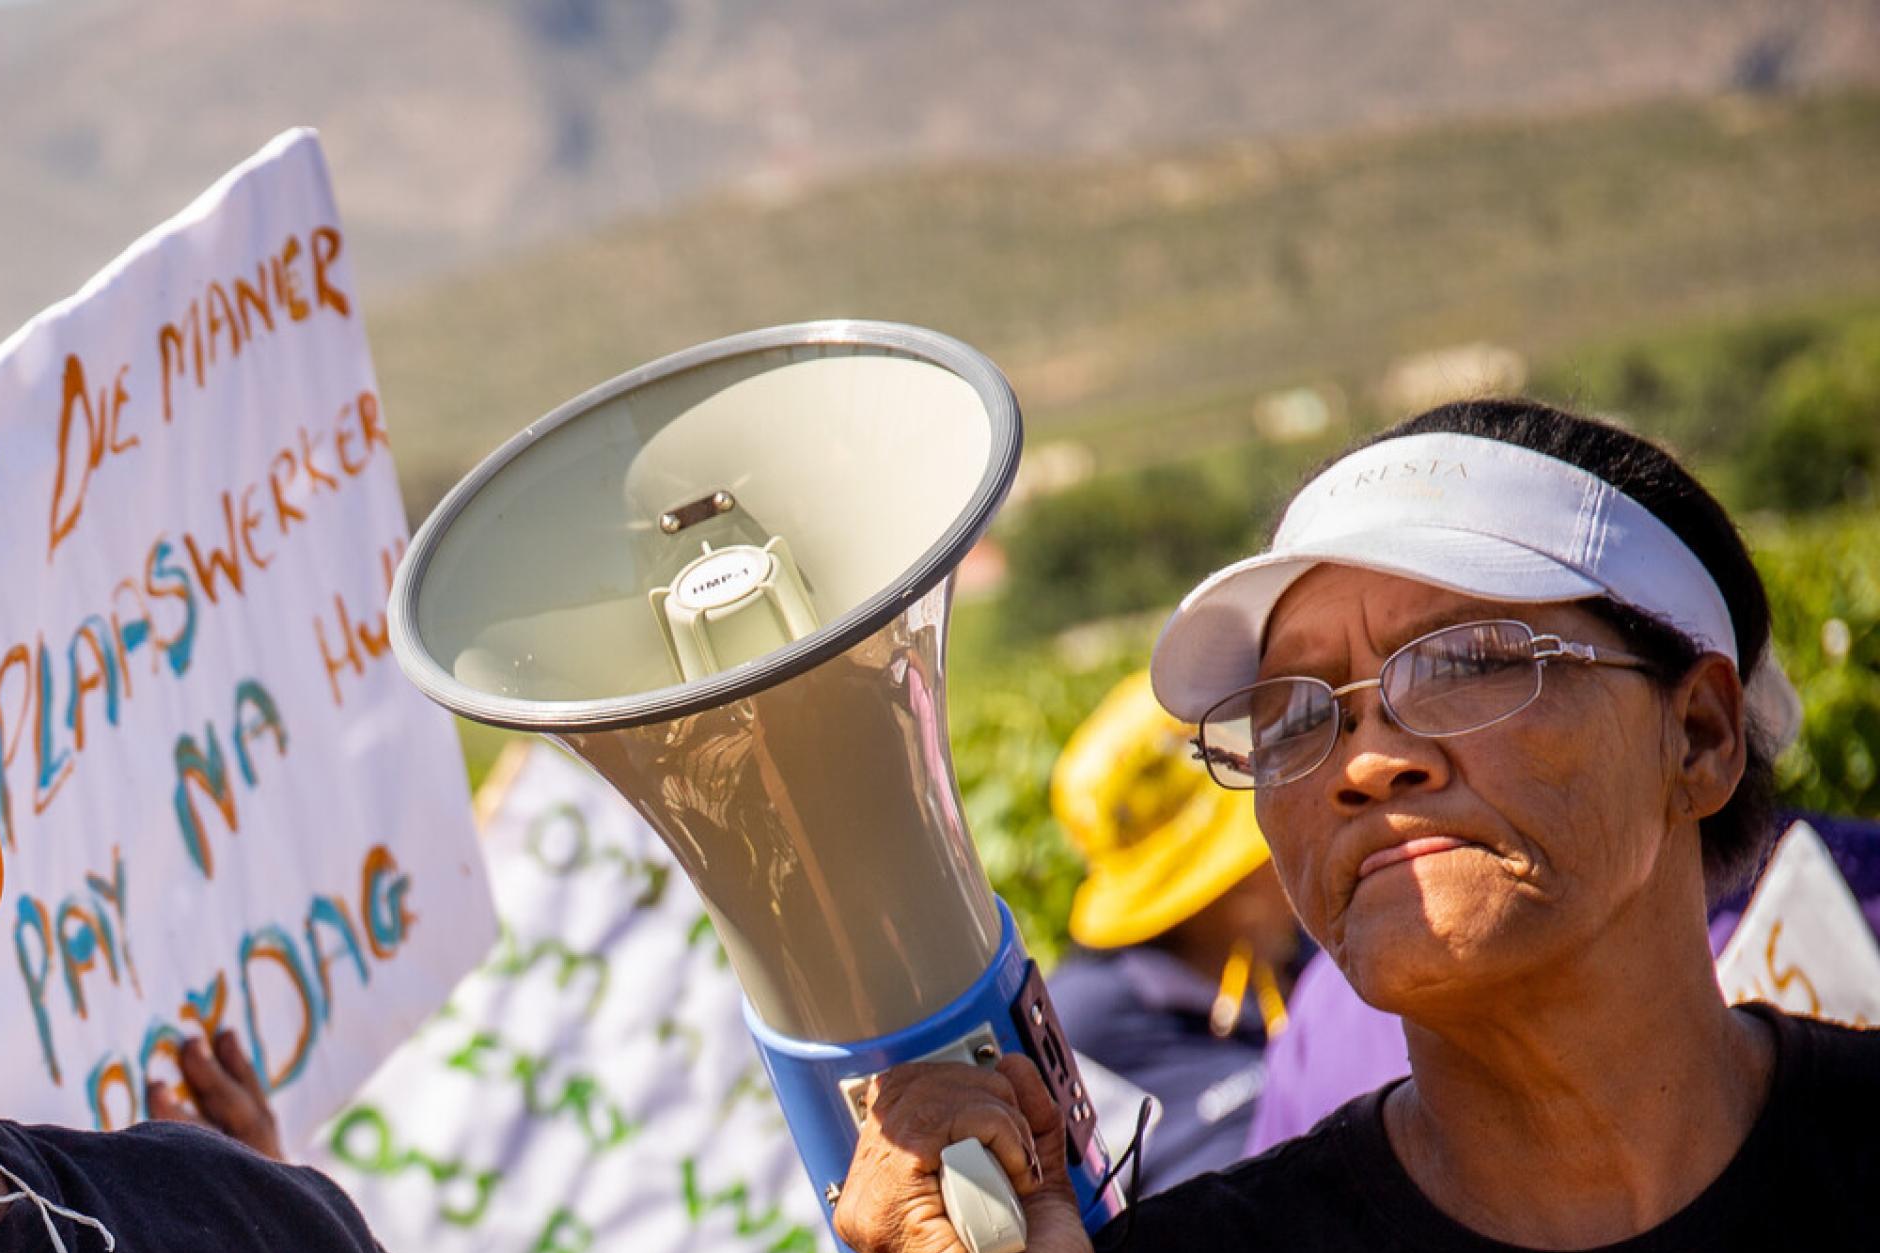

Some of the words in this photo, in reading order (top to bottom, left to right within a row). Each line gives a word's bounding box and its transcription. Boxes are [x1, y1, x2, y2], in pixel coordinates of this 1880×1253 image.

[158, 225, 351, 425] MANIER
[14, 843, 143, 1087] PAY
[174, 678, 289, 881] NA
